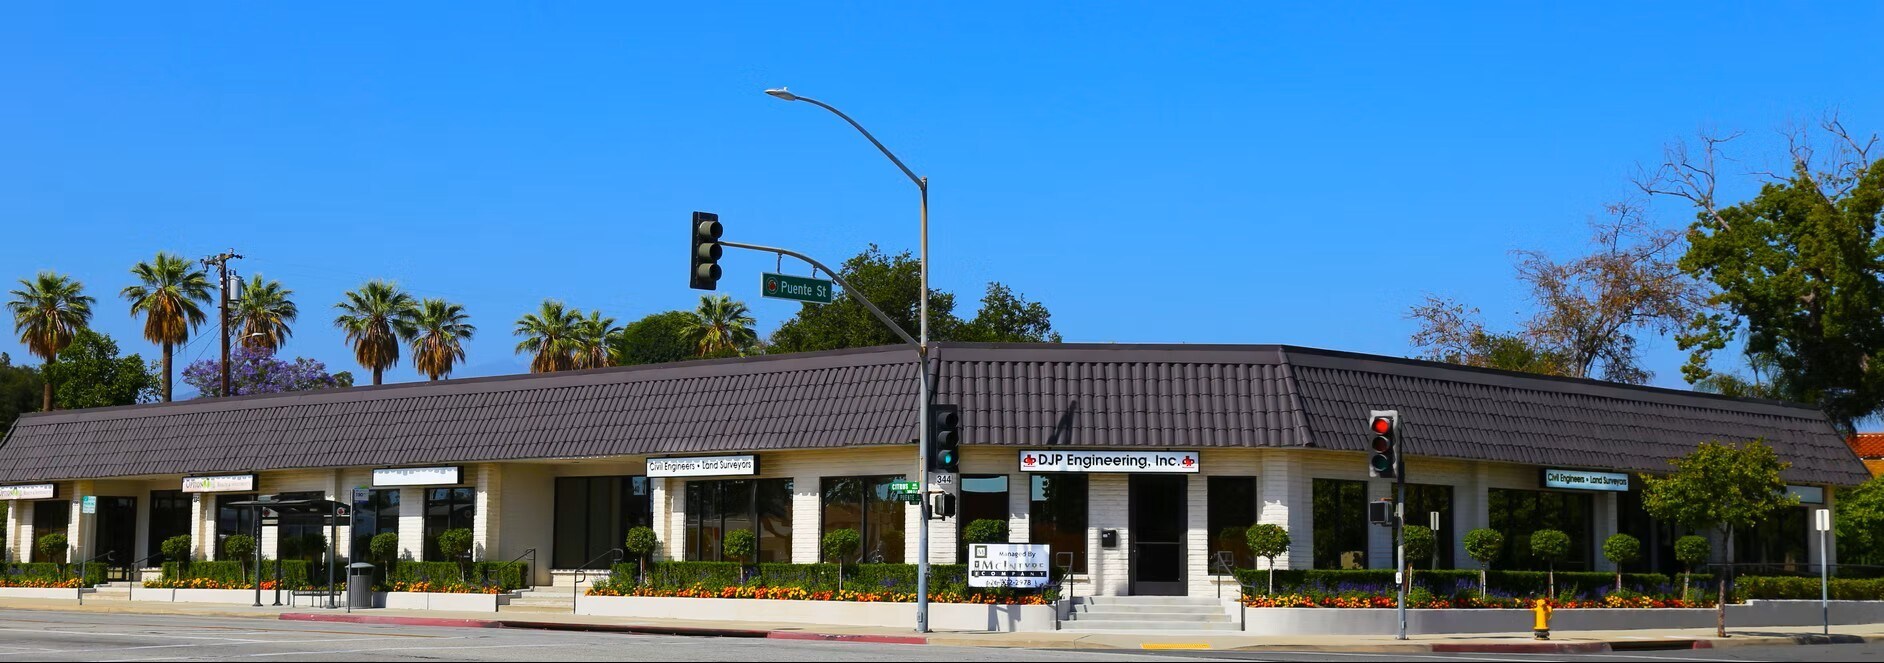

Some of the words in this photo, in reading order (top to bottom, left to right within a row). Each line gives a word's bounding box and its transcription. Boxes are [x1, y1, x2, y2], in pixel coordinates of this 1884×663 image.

[781, 281, 812, 296] Puente
[816, 285, 827, 297] St
[649, 461, 663, 471] Civil
[664, 461, 695, 473] Engineers
[702, 460, 718, 470] Land
[719, 459, 752, 471] Surveyors
[1038, 453, 1063, 466] DJP
[1067, 454, 1151, 469] Engineering,
[1155, 454, 1180, 467] Inc.
[936, 475, 952, 484] 344
[1547, 472, 1559, 482] Civil
[1560, 473, 1585, 484] Engineers
[1590, 475, 1603, 484] Land
[1603, 476, 1627, 487] Surveyors
